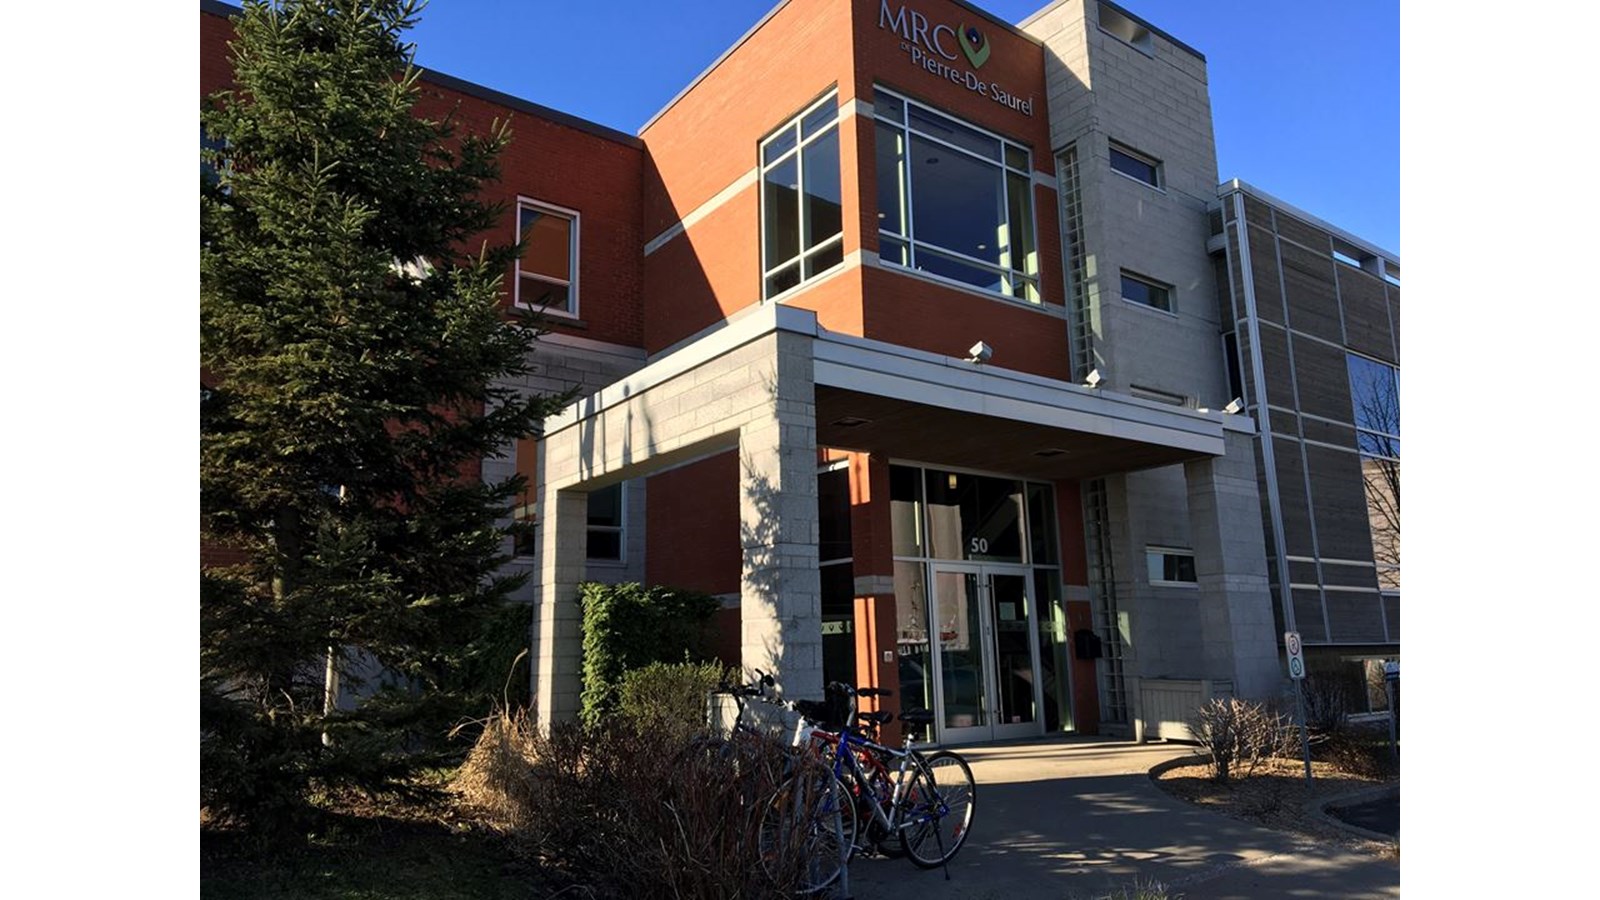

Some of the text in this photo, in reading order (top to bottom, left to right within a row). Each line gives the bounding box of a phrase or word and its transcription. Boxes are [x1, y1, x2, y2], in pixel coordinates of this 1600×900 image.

[879, 0, 958, 60] MRC
[911, 47, 987, 96] Pierre-De
[990, 83, 1033, 116] Saurel
[971, 537, 988, 553] 50
